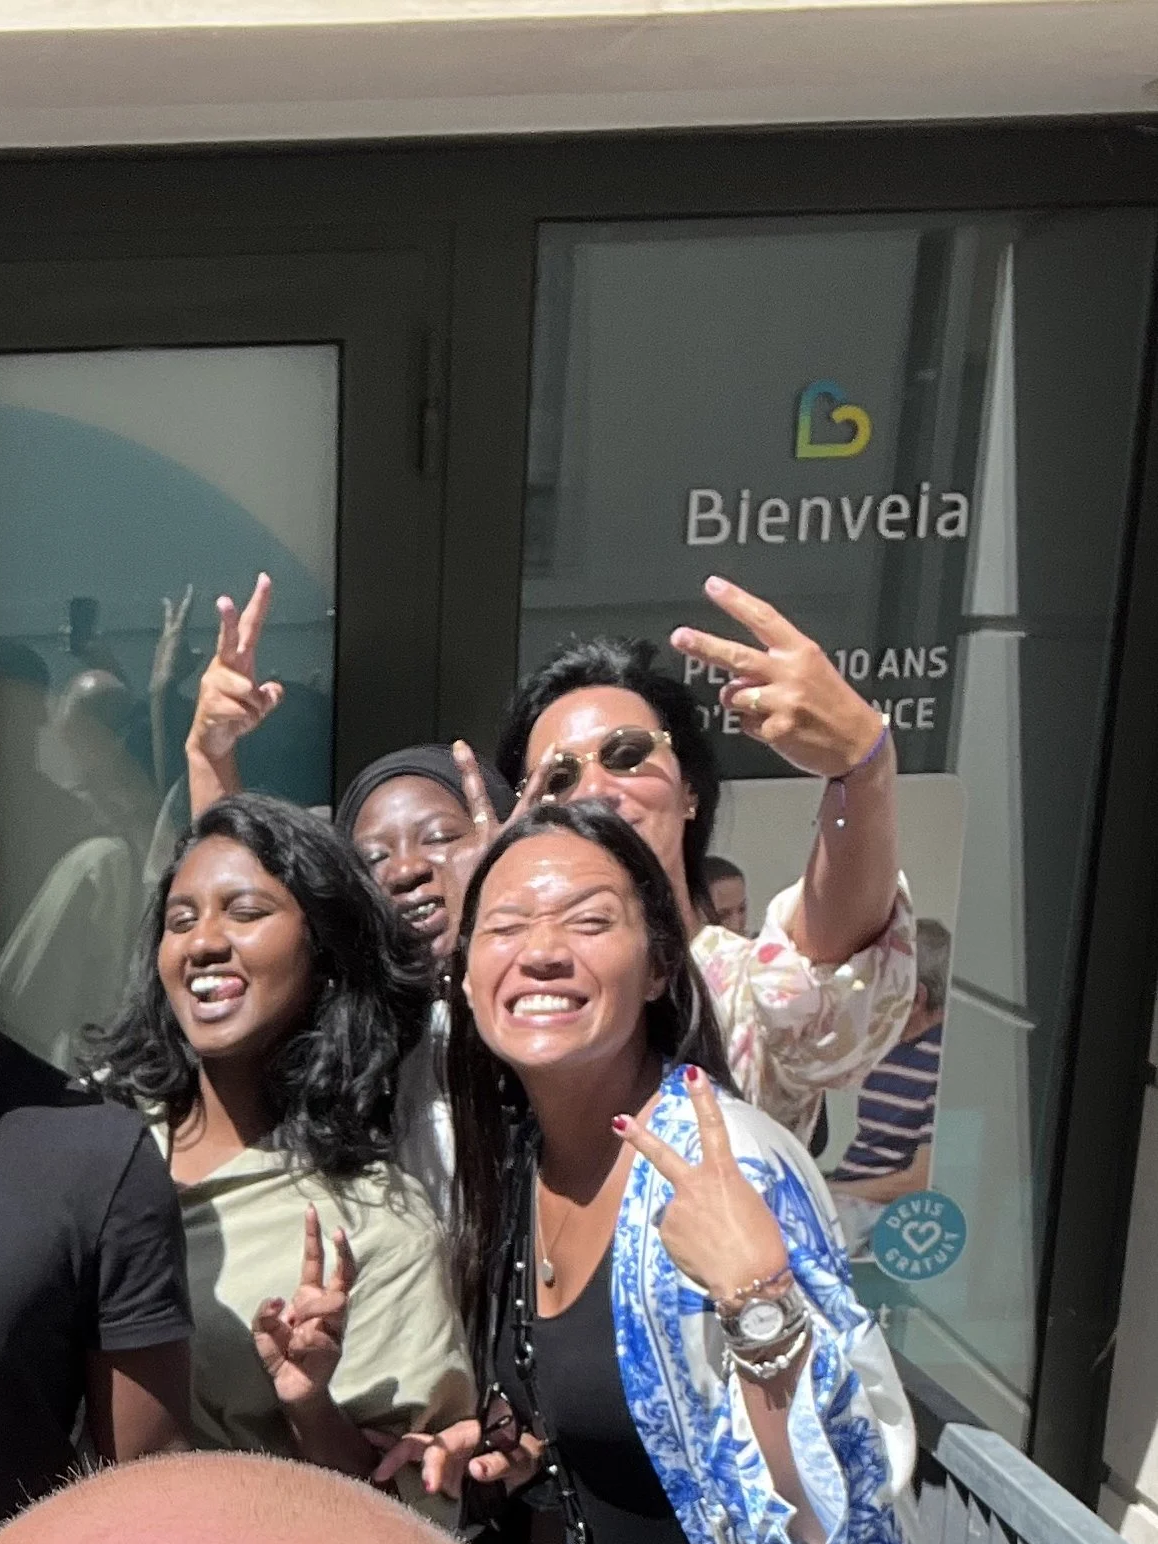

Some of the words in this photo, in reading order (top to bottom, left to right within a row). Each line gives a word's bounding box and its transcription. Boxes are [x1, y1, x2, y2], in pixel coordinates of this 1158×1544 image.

[687, 481, 969, 545] Bienveia
[834, 648, 869, 680] 10
[877, 646, 949, 679] ANS
[886, 1199, 945, 1228] DEVIS
[885, 1231, 960, 1274] GRATUIT
